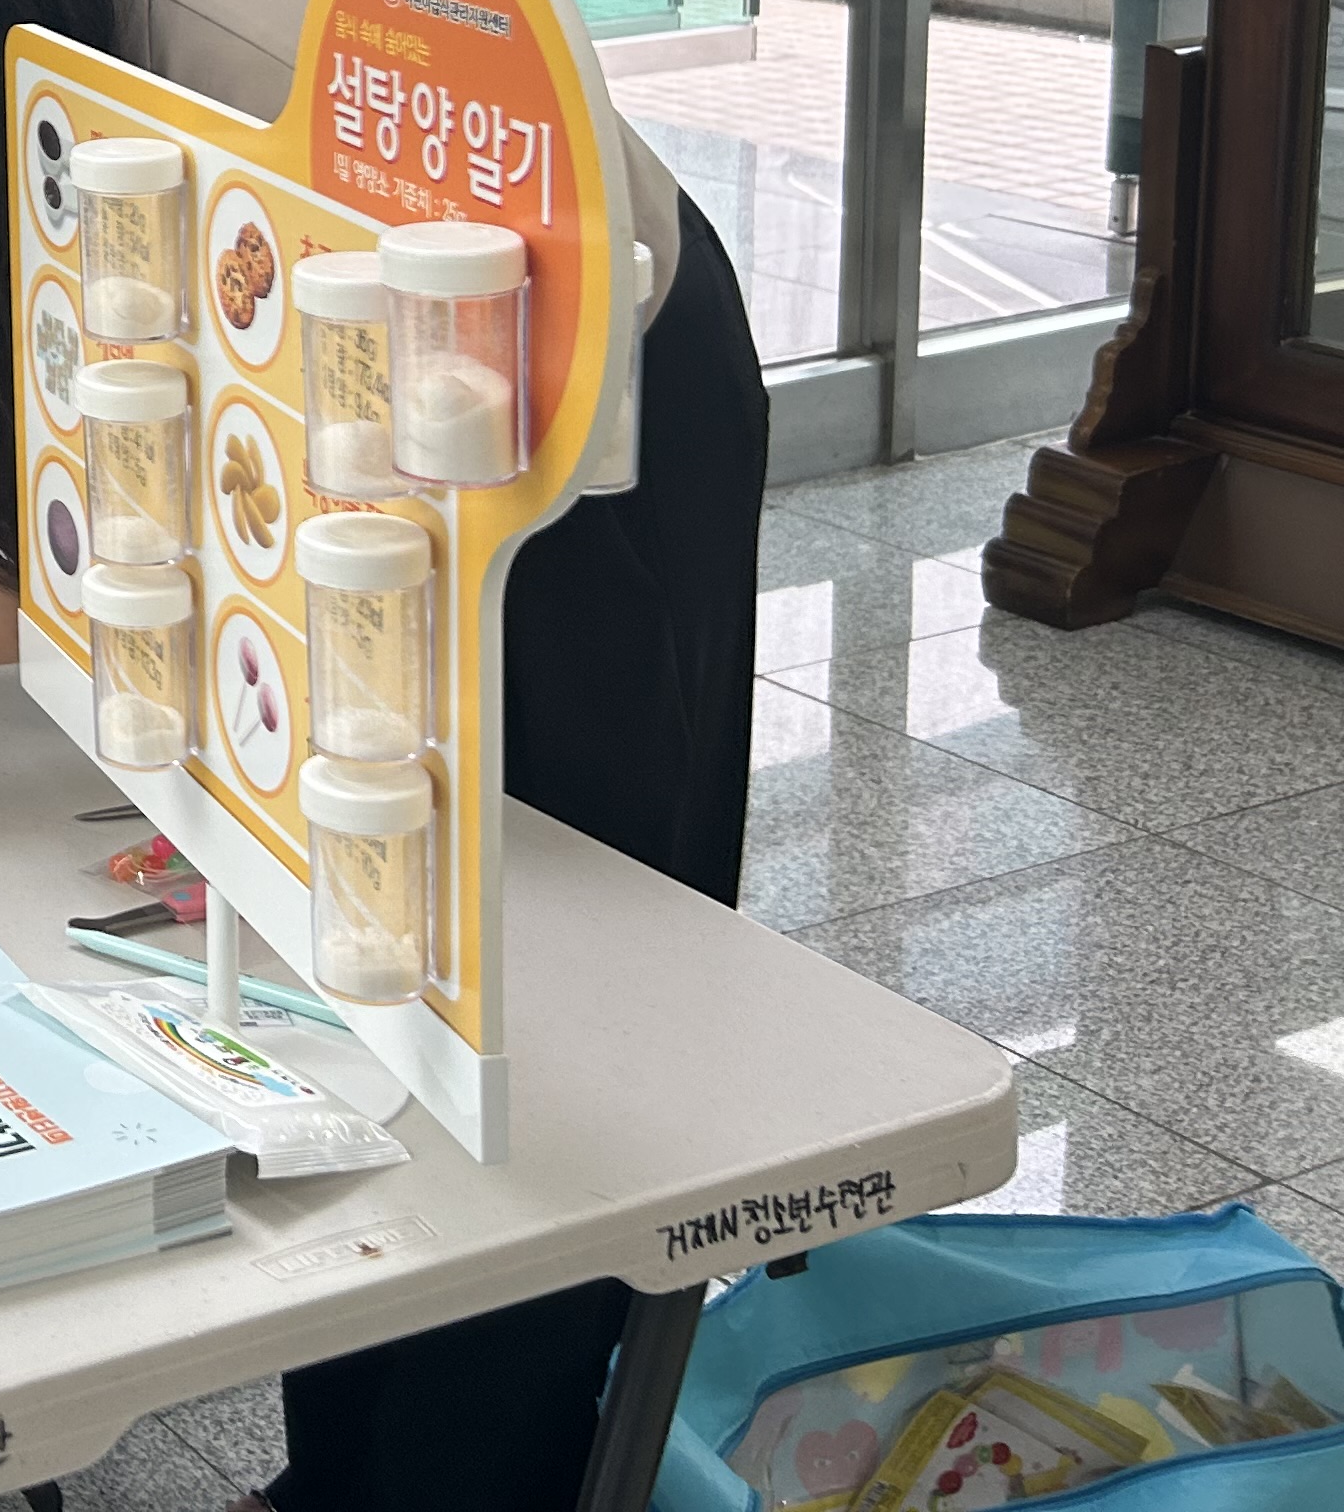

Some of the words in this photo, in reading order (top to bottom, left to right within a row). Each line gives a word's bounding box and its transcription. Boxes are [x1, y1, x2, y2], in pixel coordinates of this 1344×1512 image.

[327, 52, 409, 163] 설탕
[411, 82, 456, 182] 양
[461, 100, 553, 226] 알기
[352, 159, 390, 198] 영양소
